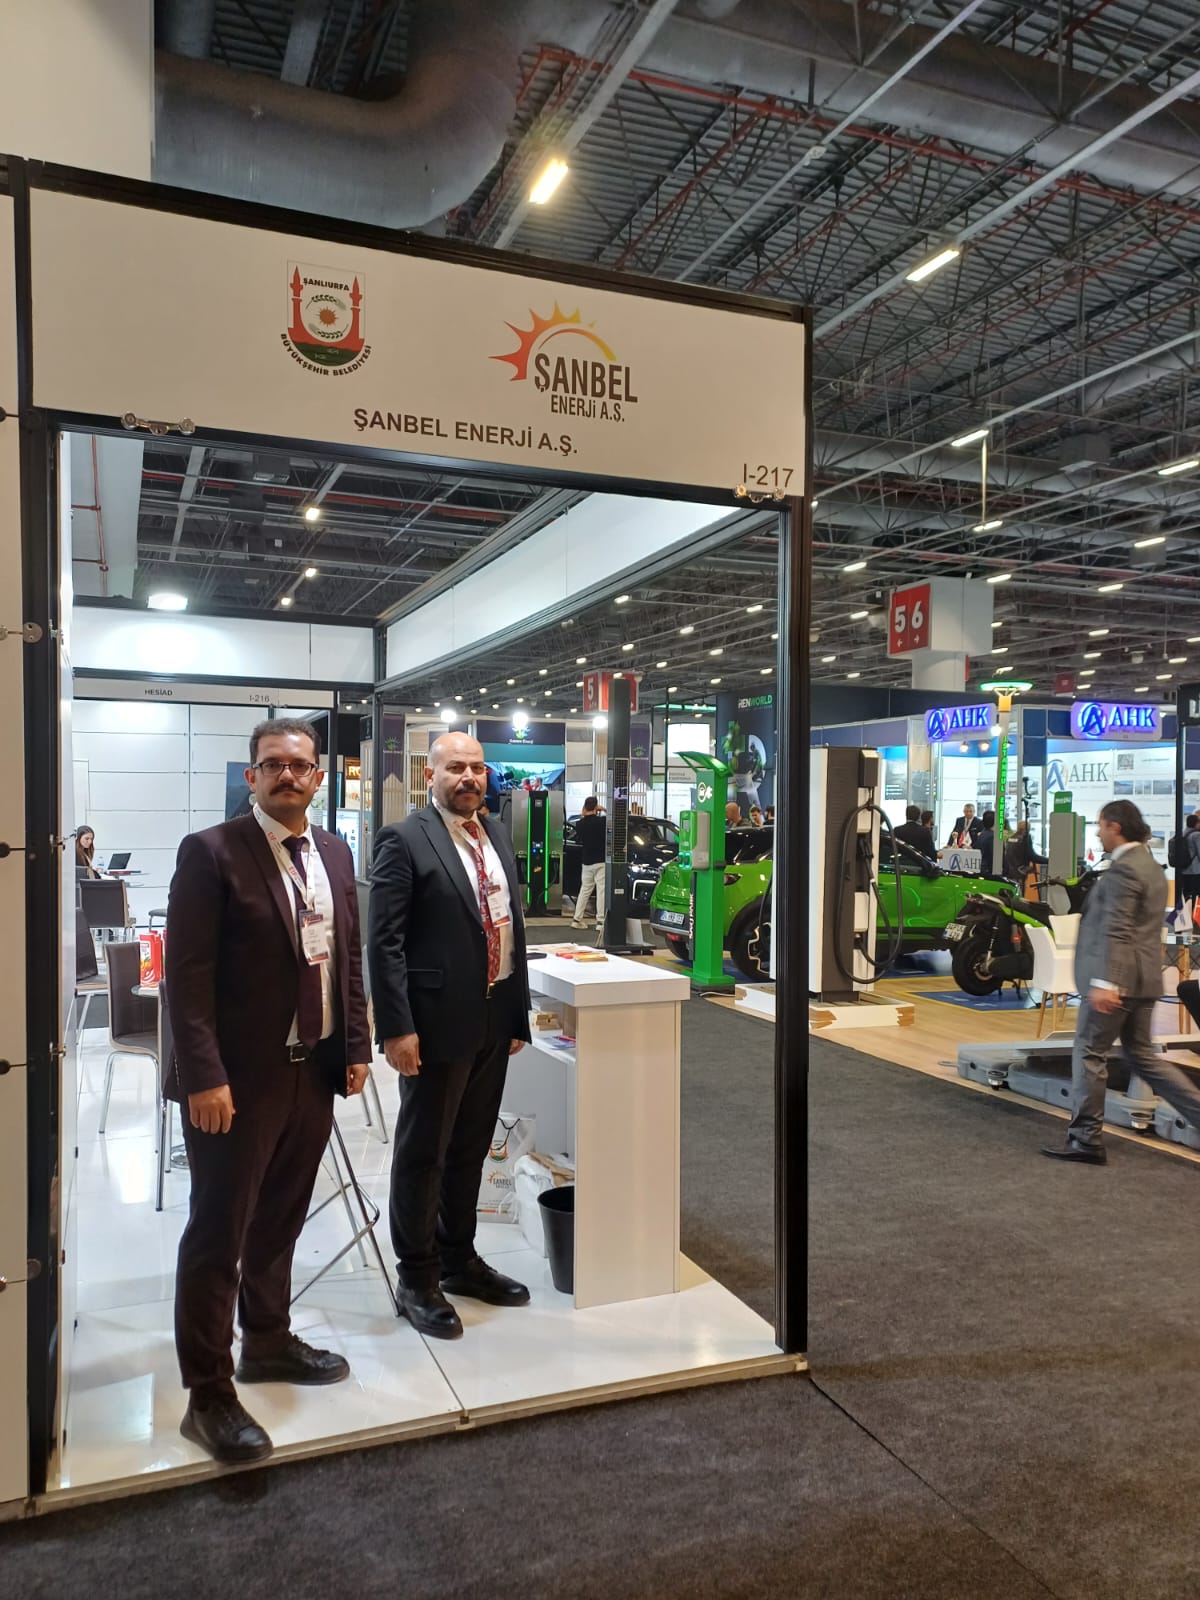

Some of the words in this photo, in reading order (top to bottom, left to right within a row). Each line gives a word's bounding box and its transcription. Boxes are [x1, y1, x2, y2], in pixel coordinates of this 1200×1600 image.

[303, 278, 350, 291] ŞANLIURFA
[332, 345, 372, 376] BELEDİYESİ
[534, 353, 638, 403] ŞANBEL
[600, 401, 625, 422] A.Ş.
[354, 408, 448, 437] ŞANBEL
[455, 421, 532, 448] ENERJİ
[538, 432, 578, 456] A.Ş.
[743, 463, 794, 488] I-217
[894, 605, 906, 633] 5
[911, 601, 924, 629] 6
[587, 677, 594, 701] 5
[950, 706, 989, 728] AHK
[1109, 706, 1156, 728] AHK
[1069, 762, 1110, 782] AHK
